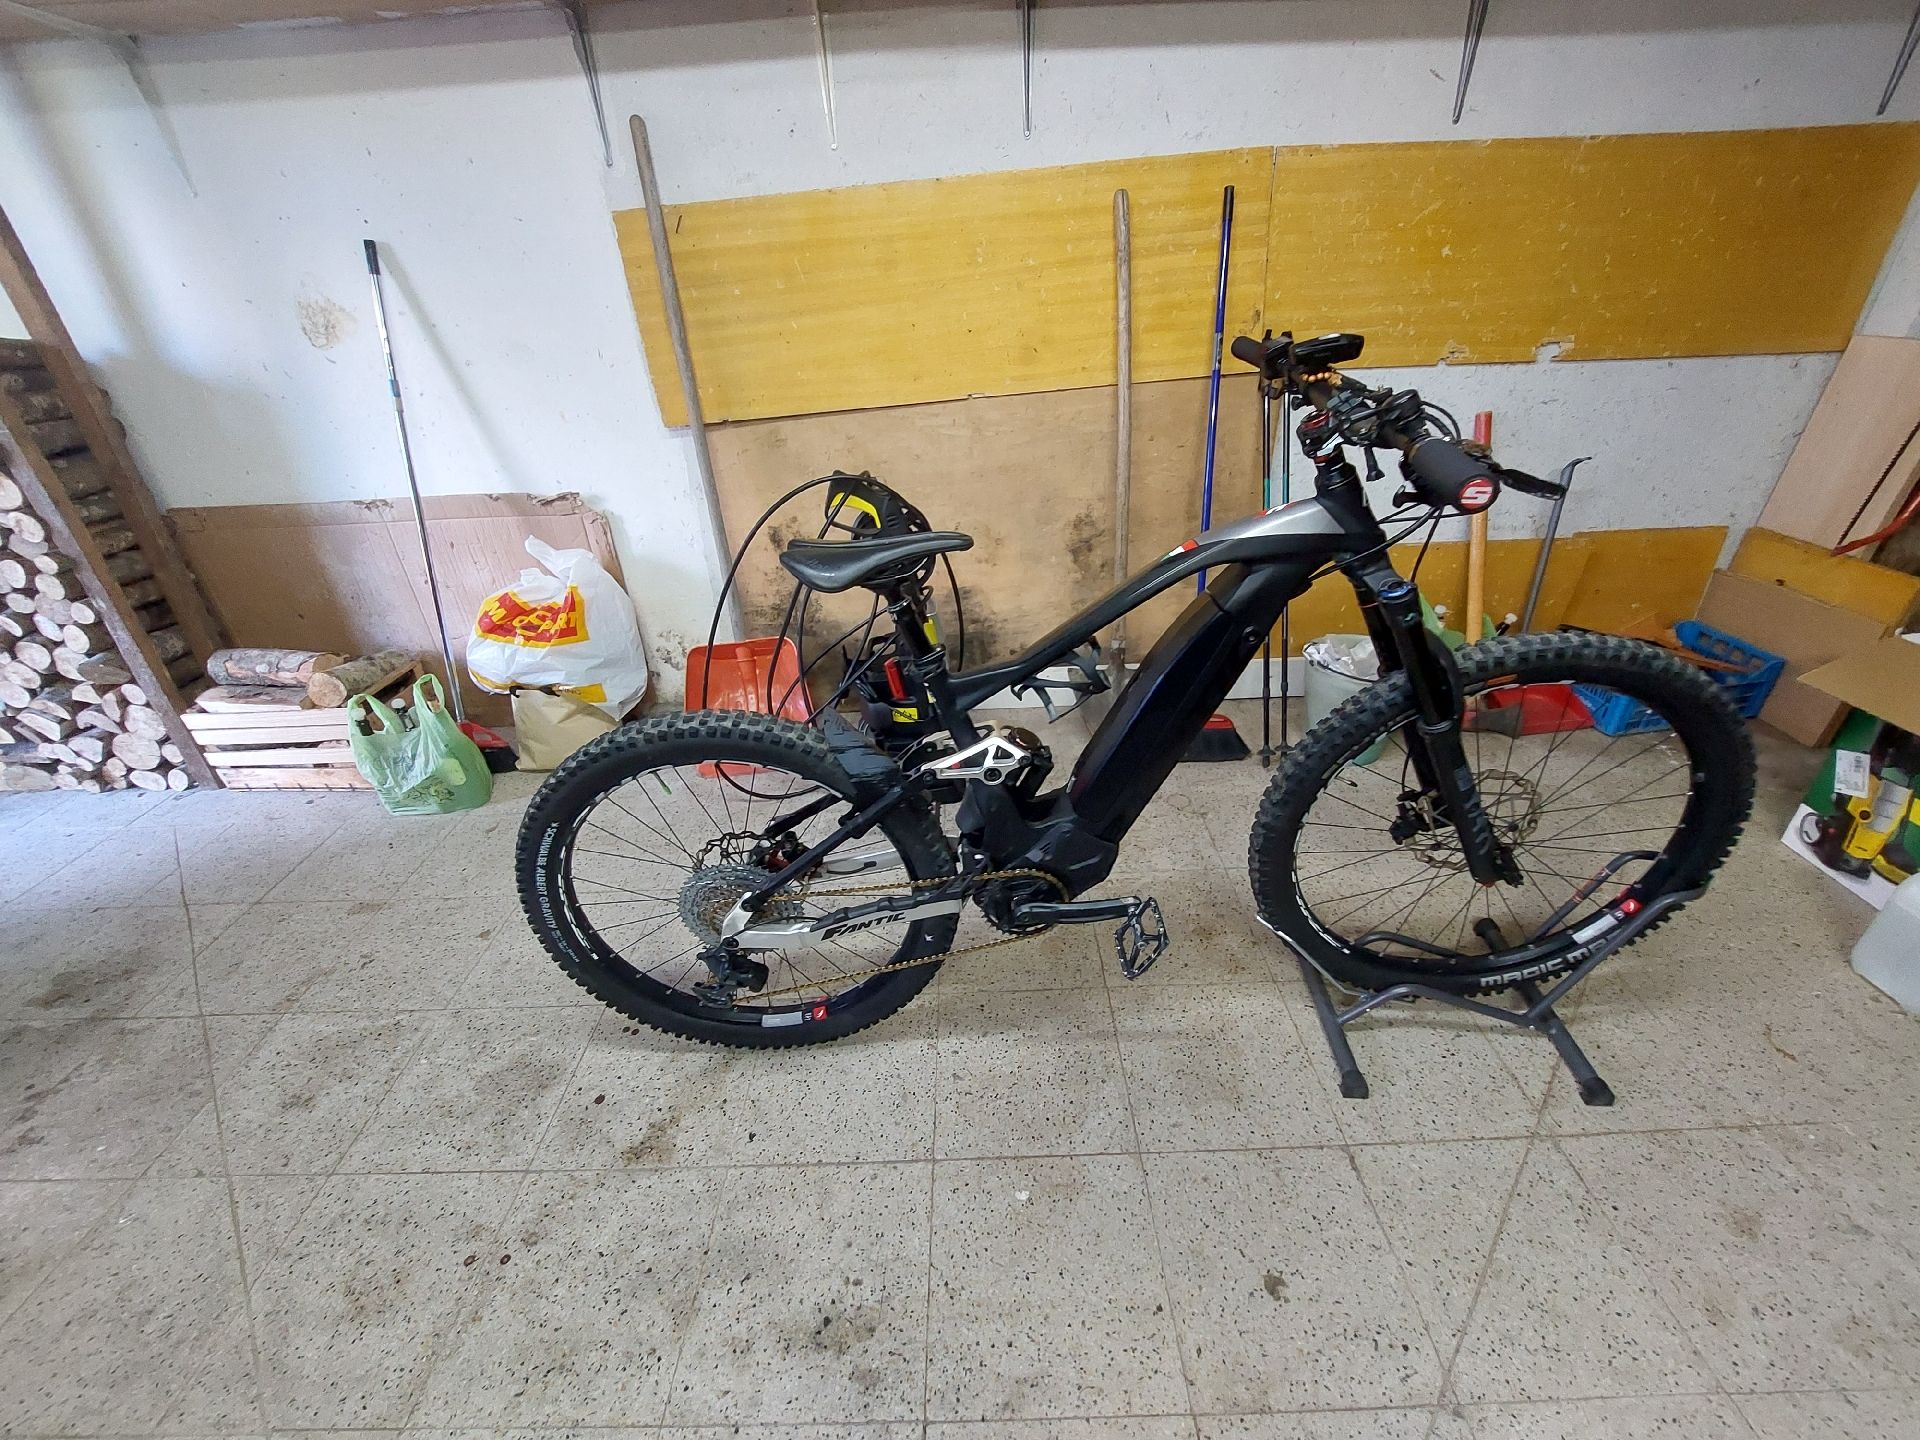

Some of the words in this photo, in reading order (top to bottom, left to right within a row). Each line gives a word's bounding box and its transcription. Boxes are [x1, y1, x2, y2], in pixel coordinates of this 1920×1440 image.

[536, 828, 557, 866] SCHWALBE
[536, 867, 548, 896] ALBERT
[539, 897, 558, 929] GRAVITY
[821, 912, 906, 941] FANTIC
[1480, 958, 1564, 987] MAGIC
